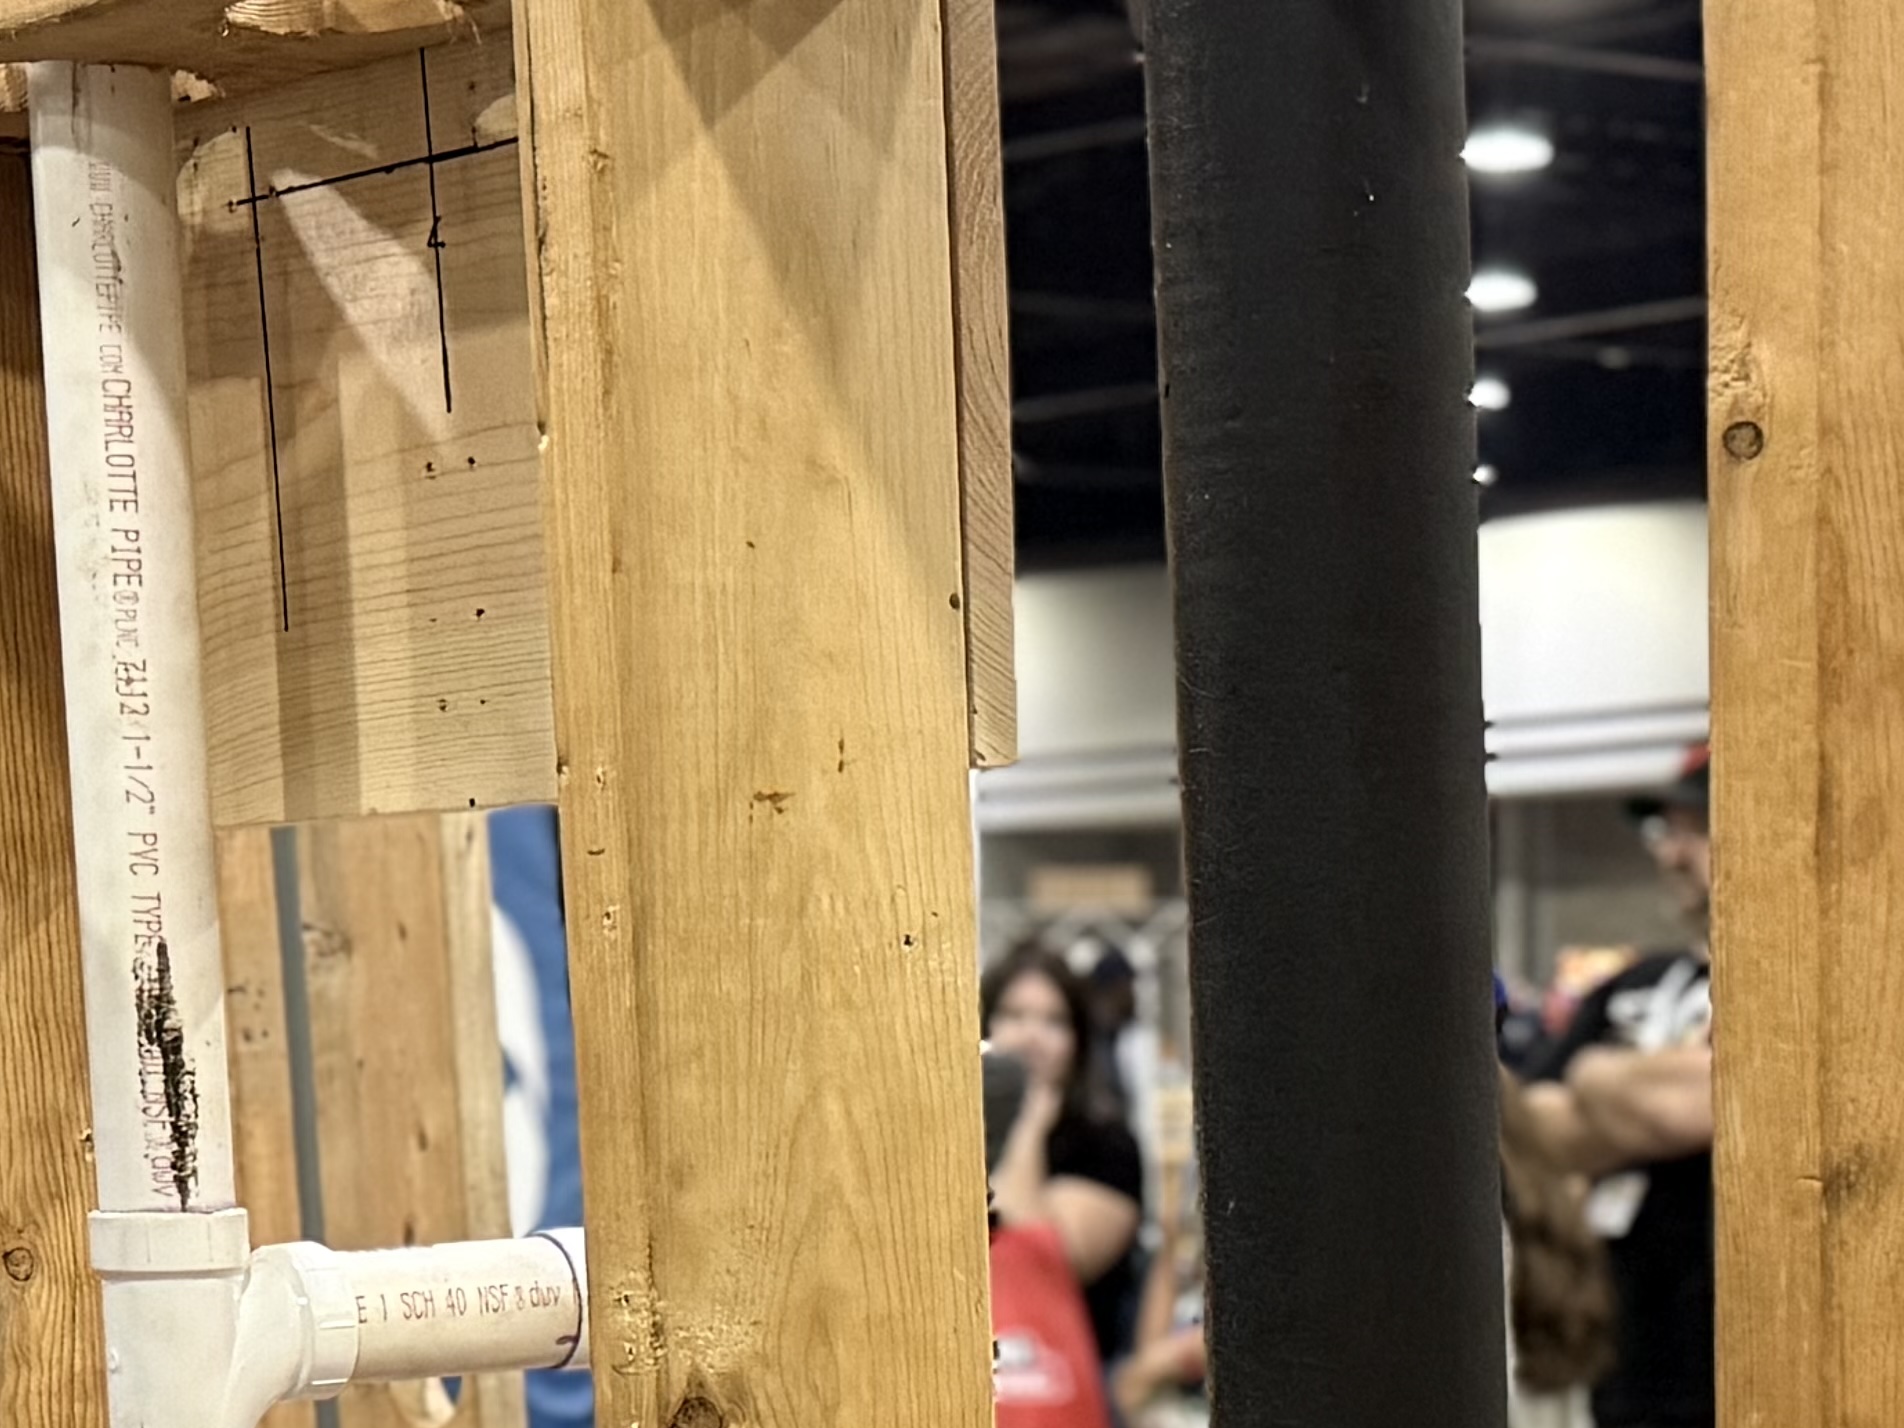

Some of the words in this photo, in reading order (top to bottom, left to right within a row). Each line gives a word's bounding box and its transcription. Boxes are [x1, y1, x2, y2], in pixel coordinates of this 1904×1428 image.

[101, 378, 139, 514] CHARLOTTE
[110, 528, 144, 588] PIPE
[127, 831, 159, 876] PVC
[131, 891, 166, 944] TYPE
[399, 1289, 436, 1321] SCH
[445, 1286, 467, 1319] 40
[477, 1283, 509, 1316] NSF
